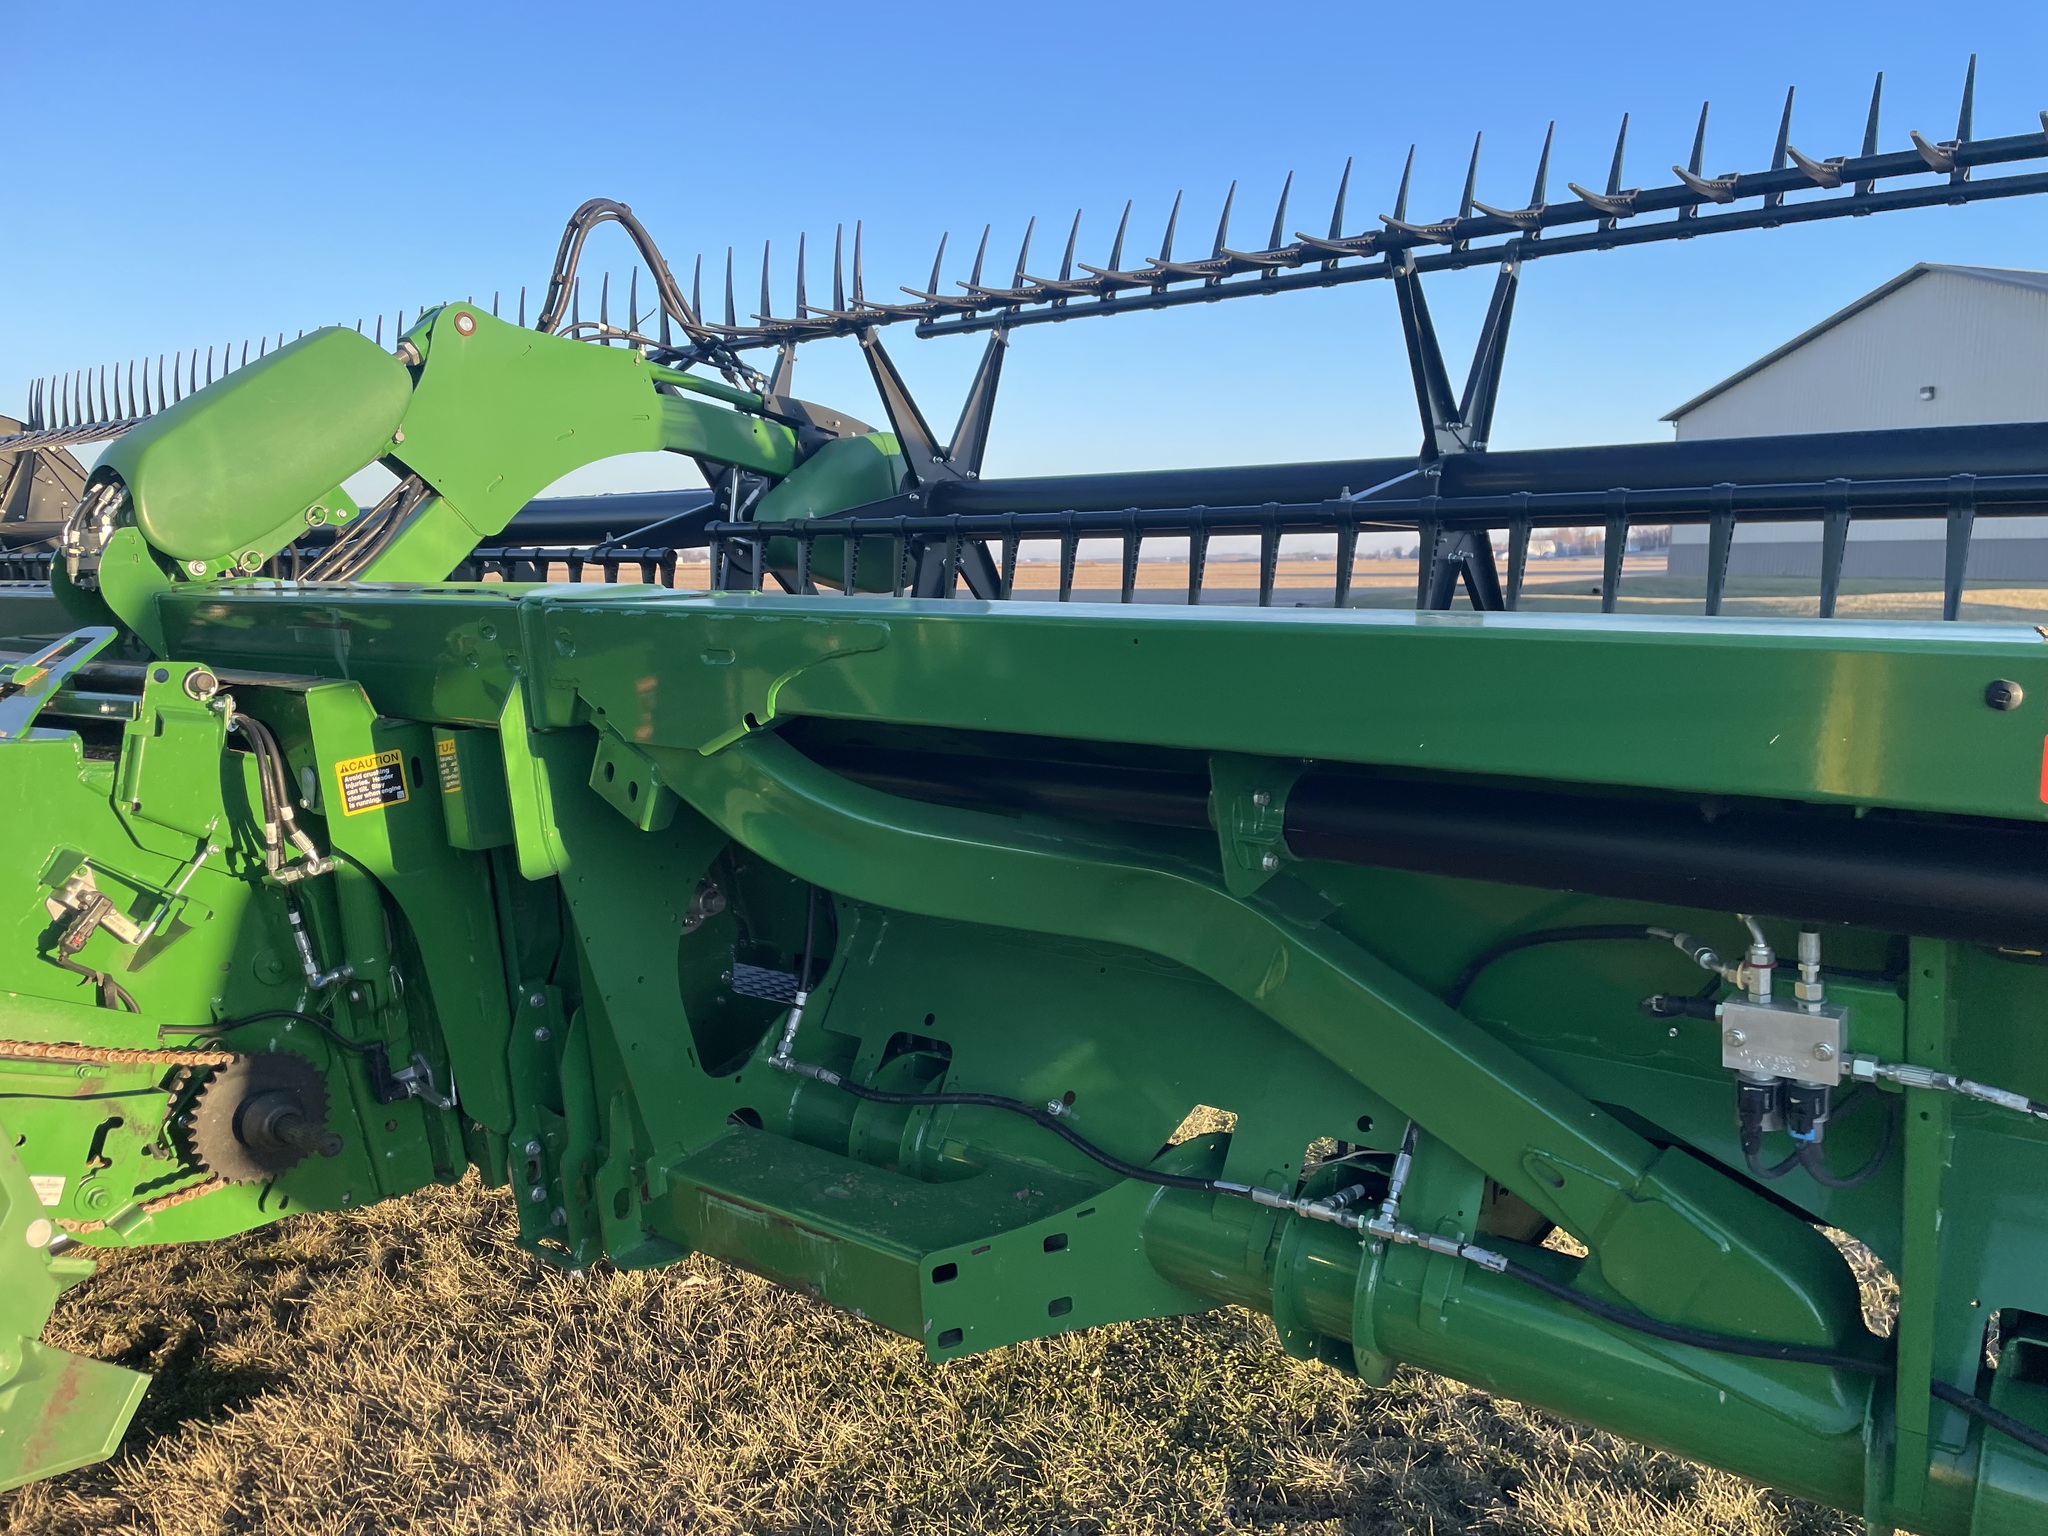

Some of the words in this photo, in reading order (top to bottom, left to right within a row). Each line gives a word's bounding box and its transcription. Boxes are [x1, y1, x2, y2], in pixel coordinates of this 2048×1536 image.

[349, 752, 398, 771] CAUTION
[344, 772, 362, 782] Avoid
[363, 768, 390, 778] crushing
[345, 779, 370, 789] injuries.
[372, 774, 394, 782] Header
[382, 786, 401, 794] engine
[356, 797, 381, 807] running.
